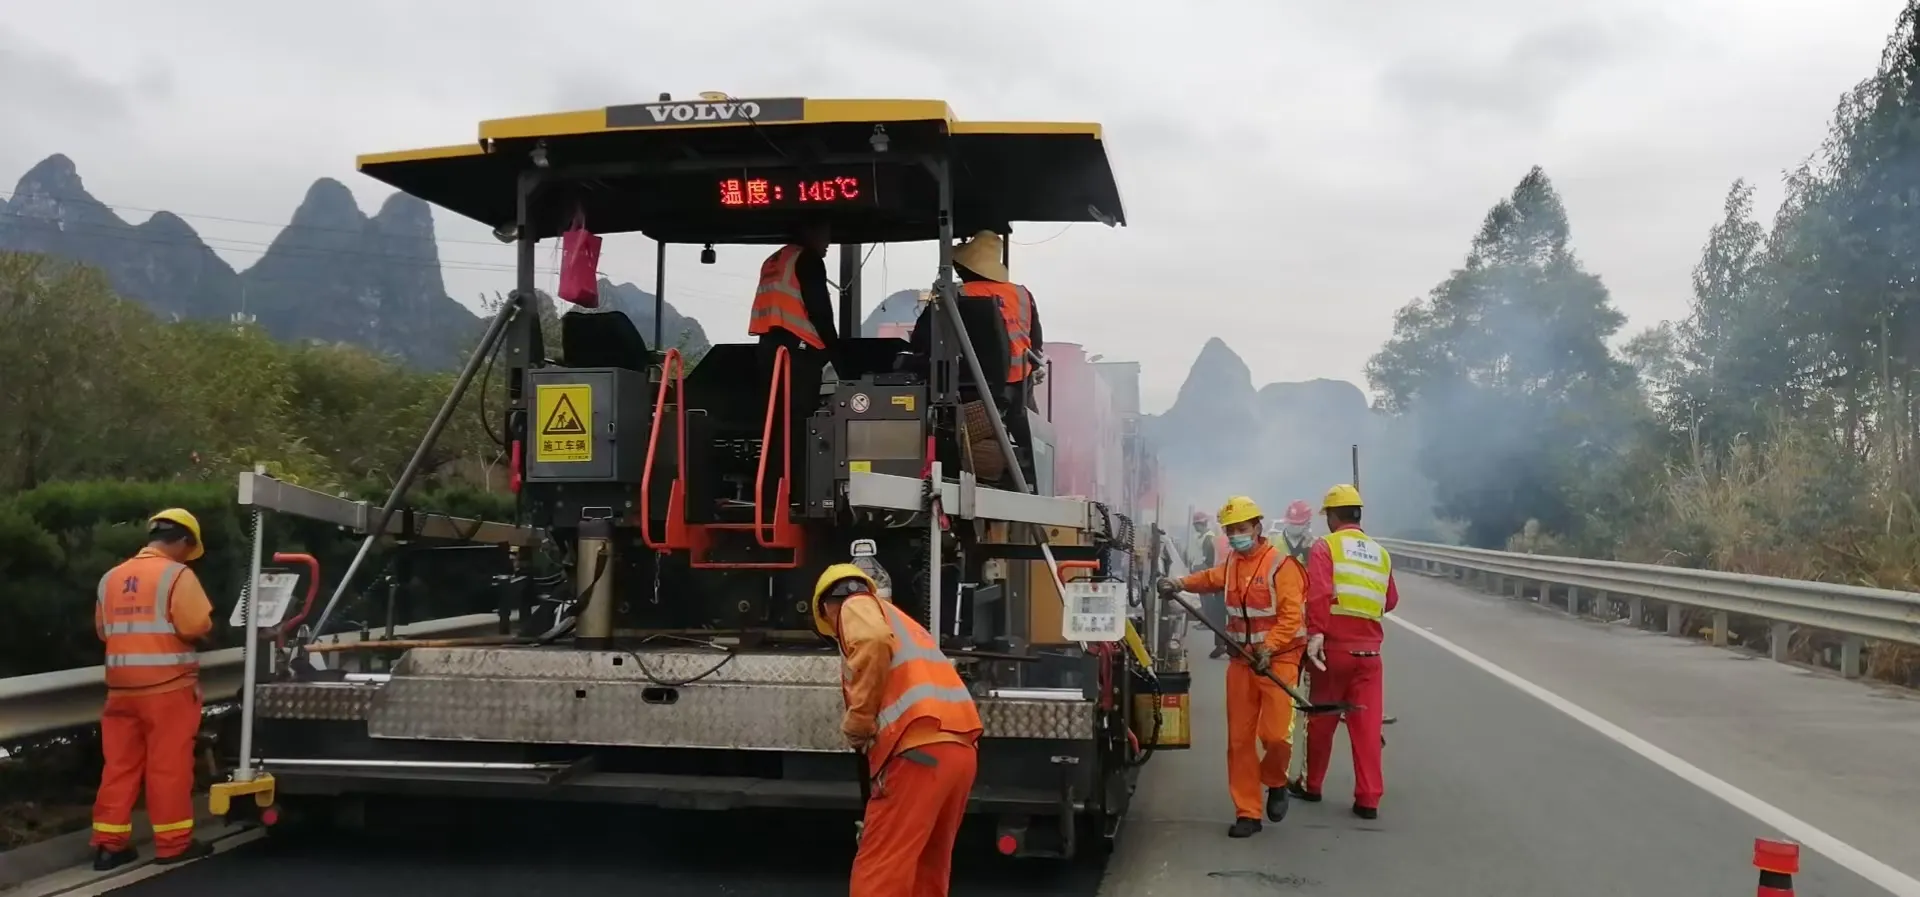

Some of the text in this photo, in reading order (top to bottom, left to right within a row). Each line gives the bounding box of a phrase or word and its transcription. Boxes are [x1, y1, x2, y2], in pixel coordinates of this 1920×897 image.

[645, 101, 761, 122] VOLVO
[543, 440, 586, 452] 施工车辆
